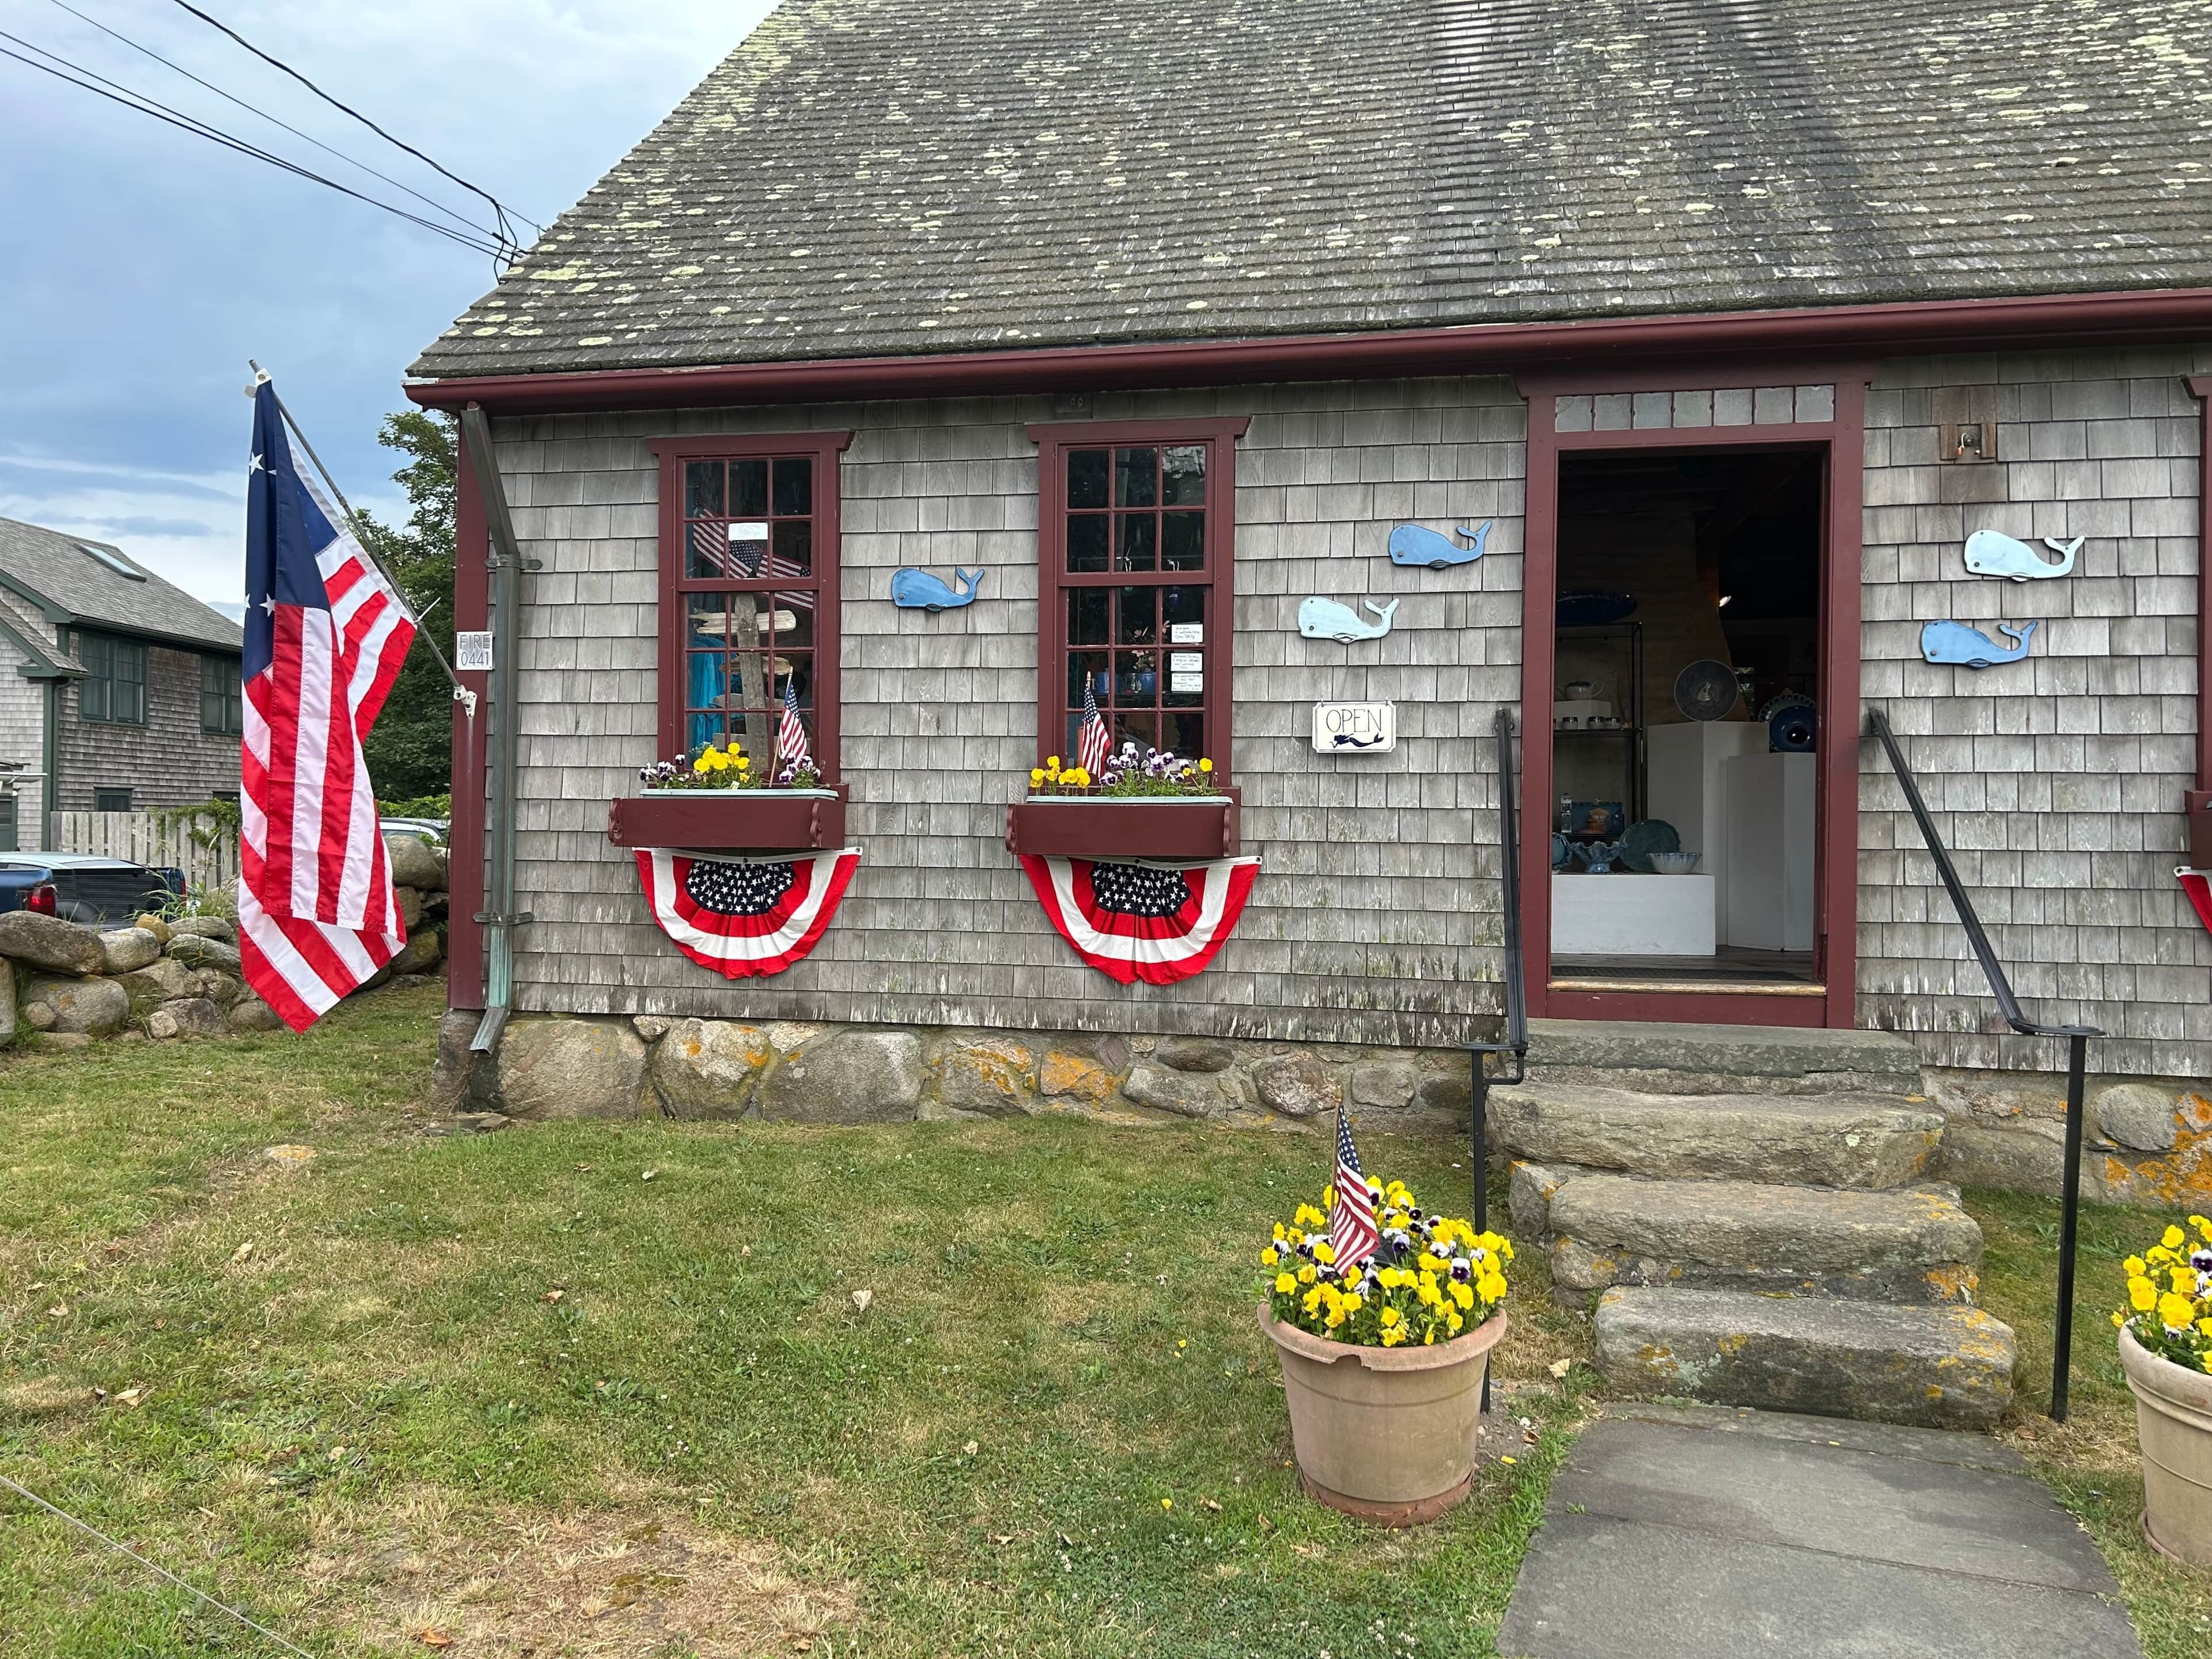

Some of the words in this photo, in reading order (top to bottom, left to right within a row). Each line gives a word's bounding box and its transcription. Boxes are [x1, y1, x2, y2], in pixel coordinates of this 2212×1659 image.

[460, 634, 490, 649] FIRE
[461, 651, 488, 666] 0441
[1326, 709, 1381, 733] OPEN
